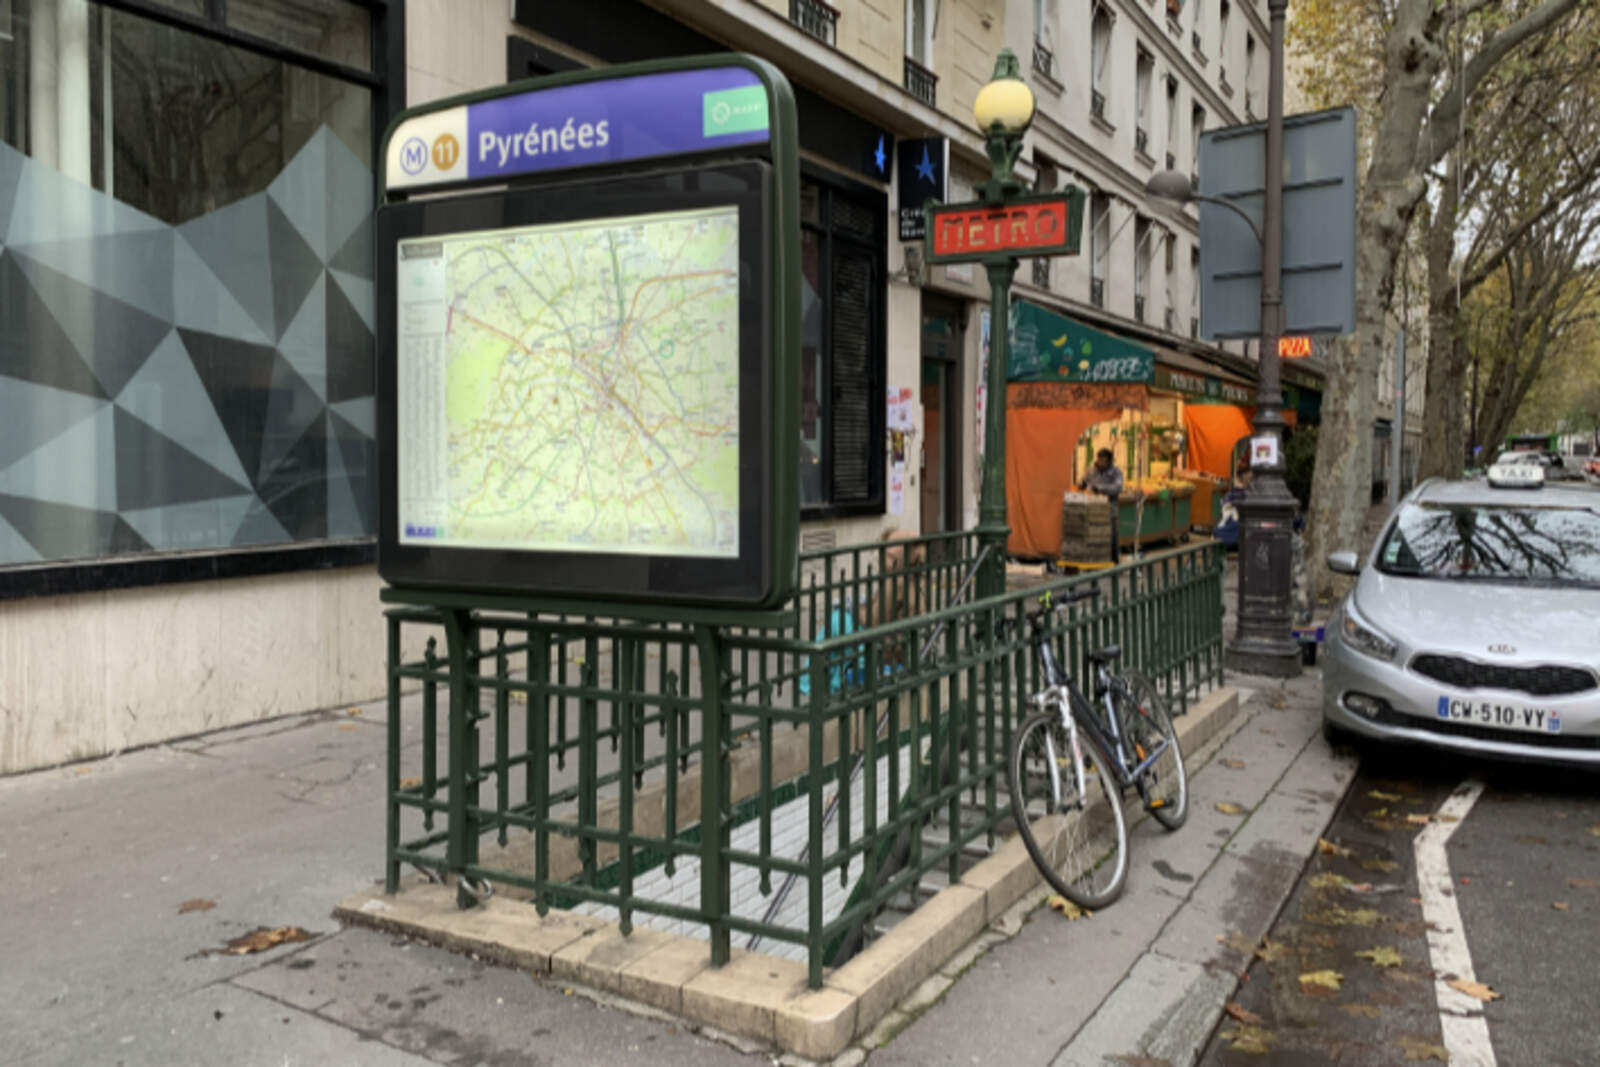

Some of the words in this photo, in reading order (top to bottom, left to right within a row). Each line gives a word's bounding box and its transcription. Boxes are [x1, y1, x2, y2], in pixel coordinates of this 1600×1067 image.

[437, 140, 454, 164] 11
[479, 118, 610, 168] Pyrénées
[941, 207, 1058, 249] METRO
[1279, 336, 1311, 358] PIZZA
[1500, 468, 1534, 478] TAXI
